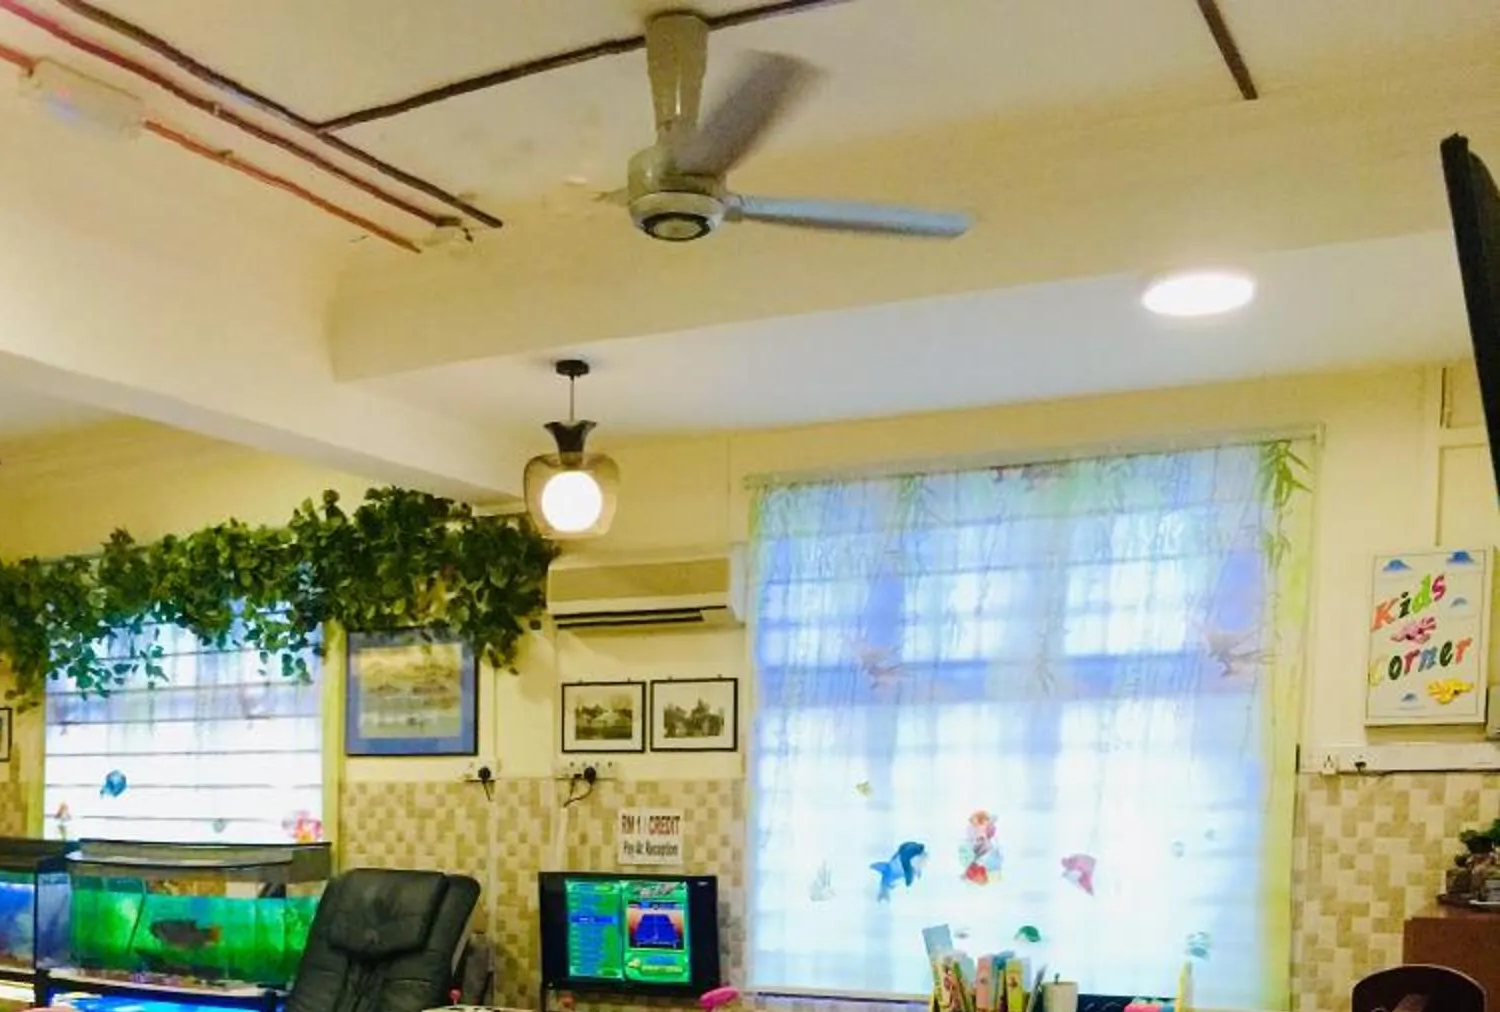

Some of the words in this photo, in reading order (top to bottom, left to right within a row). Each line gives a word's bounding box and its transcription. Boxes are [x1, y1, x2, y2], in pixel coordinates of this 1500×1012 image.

[1370, 574, 1446, 633] Kids
[1367, 637, 1473, 687] Corner
[649, 815, 680, 835] CREDIT
